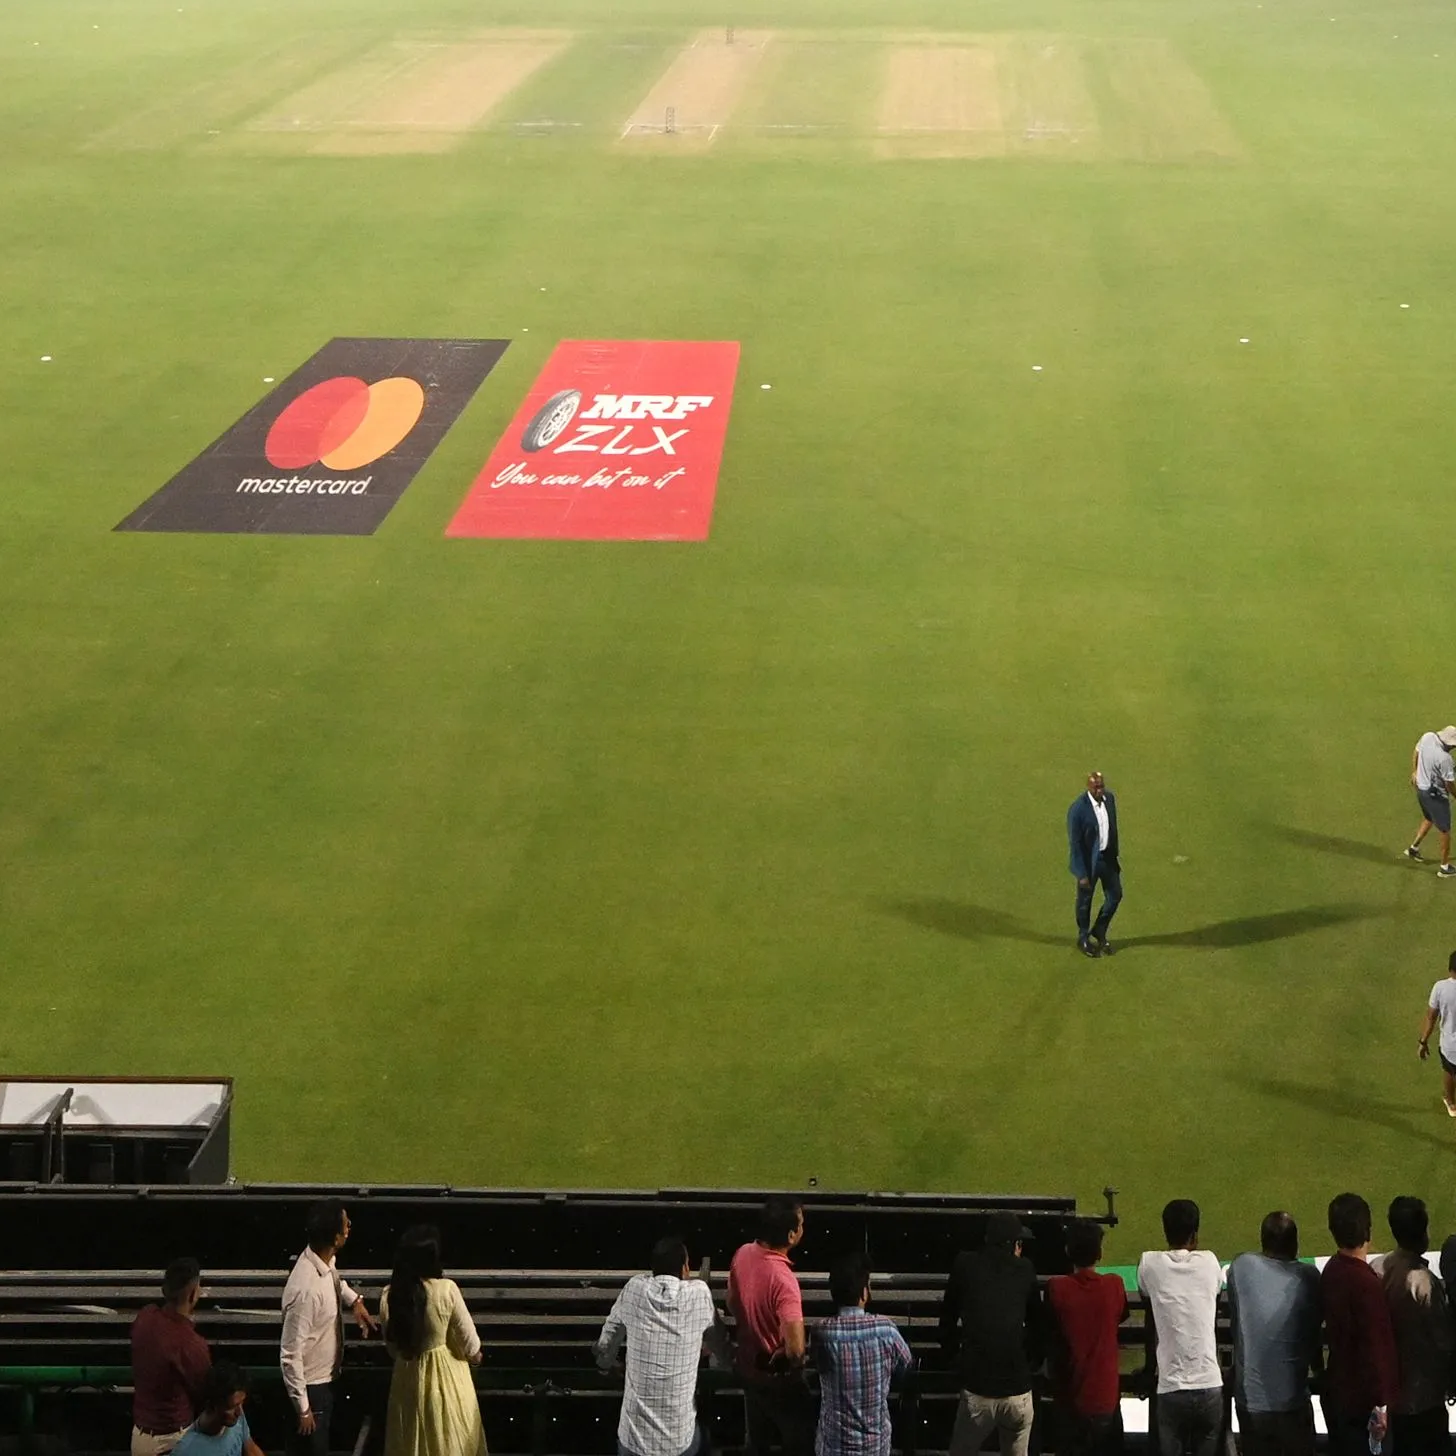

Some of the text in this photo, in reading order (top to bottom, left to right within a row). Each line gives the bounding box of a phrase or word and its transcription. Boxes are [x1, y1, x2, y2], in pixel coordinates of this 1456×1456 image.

[580, 394, 714, 420] MRF
[553, 424, 690, 455] ZLX
[237, 476, 370, 495] mastercard
[491, 462, 687, 489] You can bet on it
